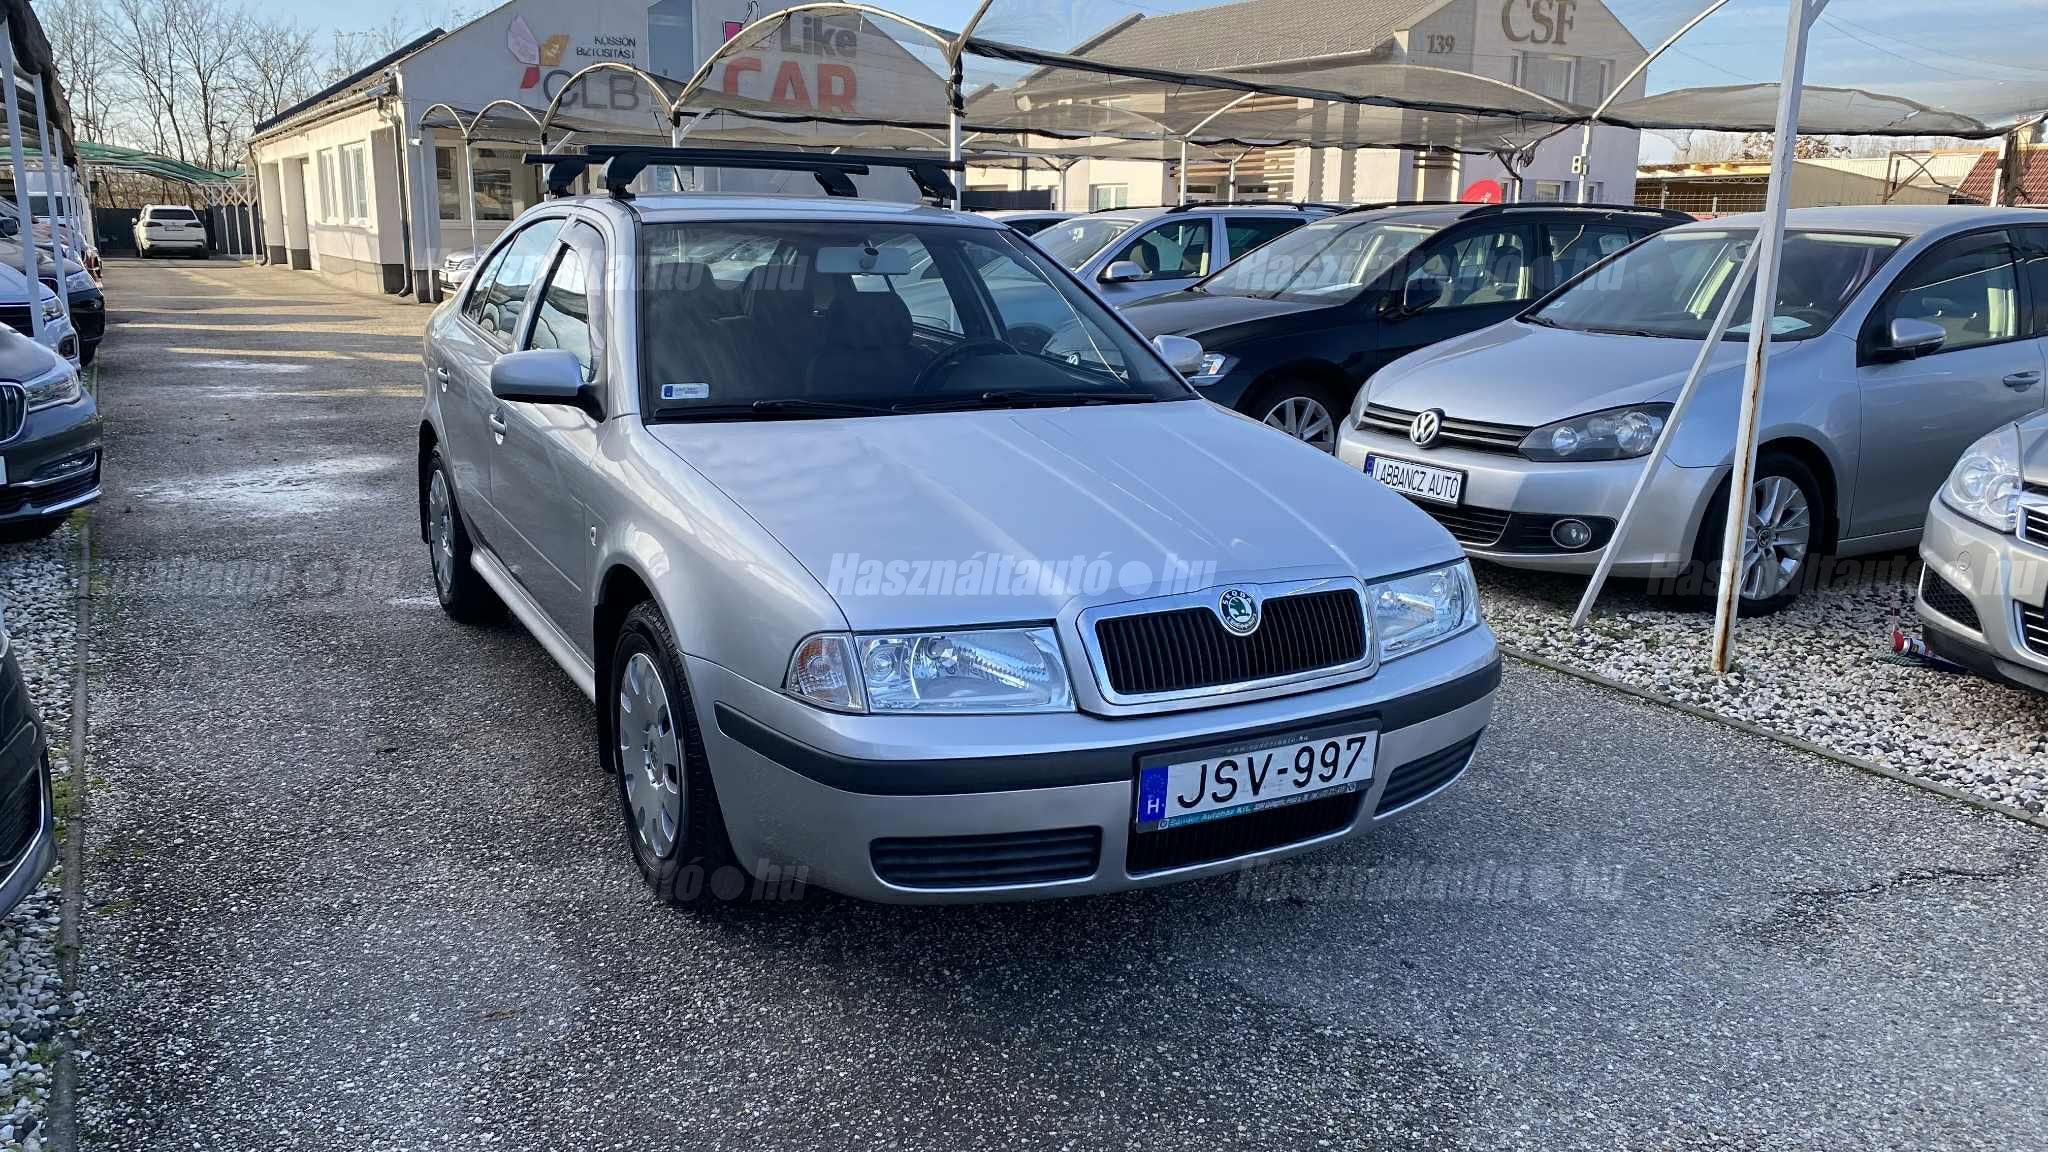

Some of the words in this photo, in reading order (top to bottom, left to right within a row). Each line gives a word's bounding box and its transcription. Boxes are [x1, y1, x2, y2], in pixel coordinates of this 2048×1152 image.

[781, 15, 857, 58] Like
[1427, 33, 1455, 54] 139
[1502, 0, 1576, 45] CSF
[723, 56, 863, 114] CAR
[1177, 735, 1367, 808] JSV-997
